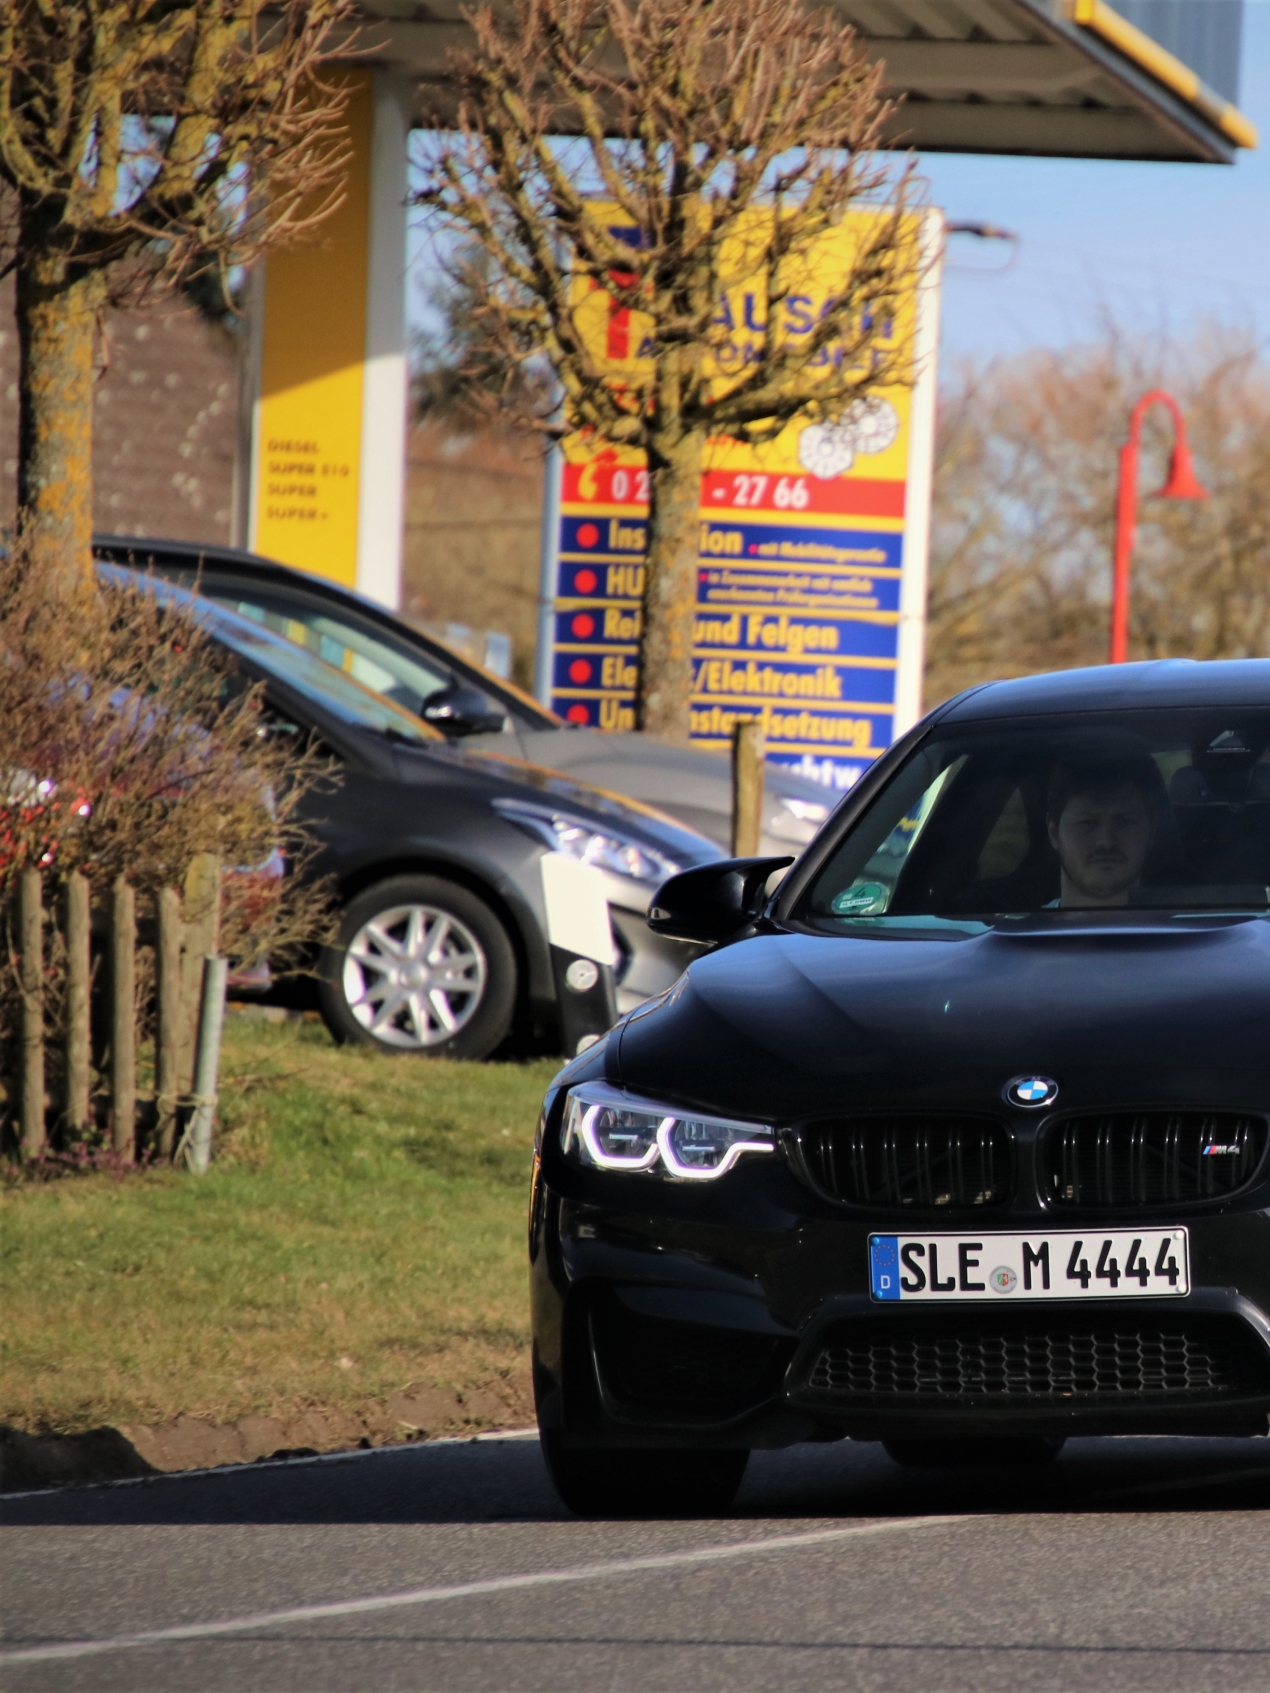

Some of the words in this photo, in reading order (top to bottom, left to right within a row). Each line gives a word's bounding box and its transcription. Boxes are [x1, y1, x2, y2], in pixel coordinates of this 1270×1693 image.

[267, 440, 319, 454] DIESEL
[268, 462, 316, 476] SUPER
[321, 464, 350, 478] E10
[267, 483, 318, 498] SUPER
[732, 474, 769, 506] 27
[772, 476, 810, 510] 66
[746, 614, 840, 654] Felgen
[880, 1275, 892, 1290] D
[900, 1242, 986, 1292] SLE
[1022, 1241, 1051, 1290] M
[1066, 1237, 1180, 1289] 4444
